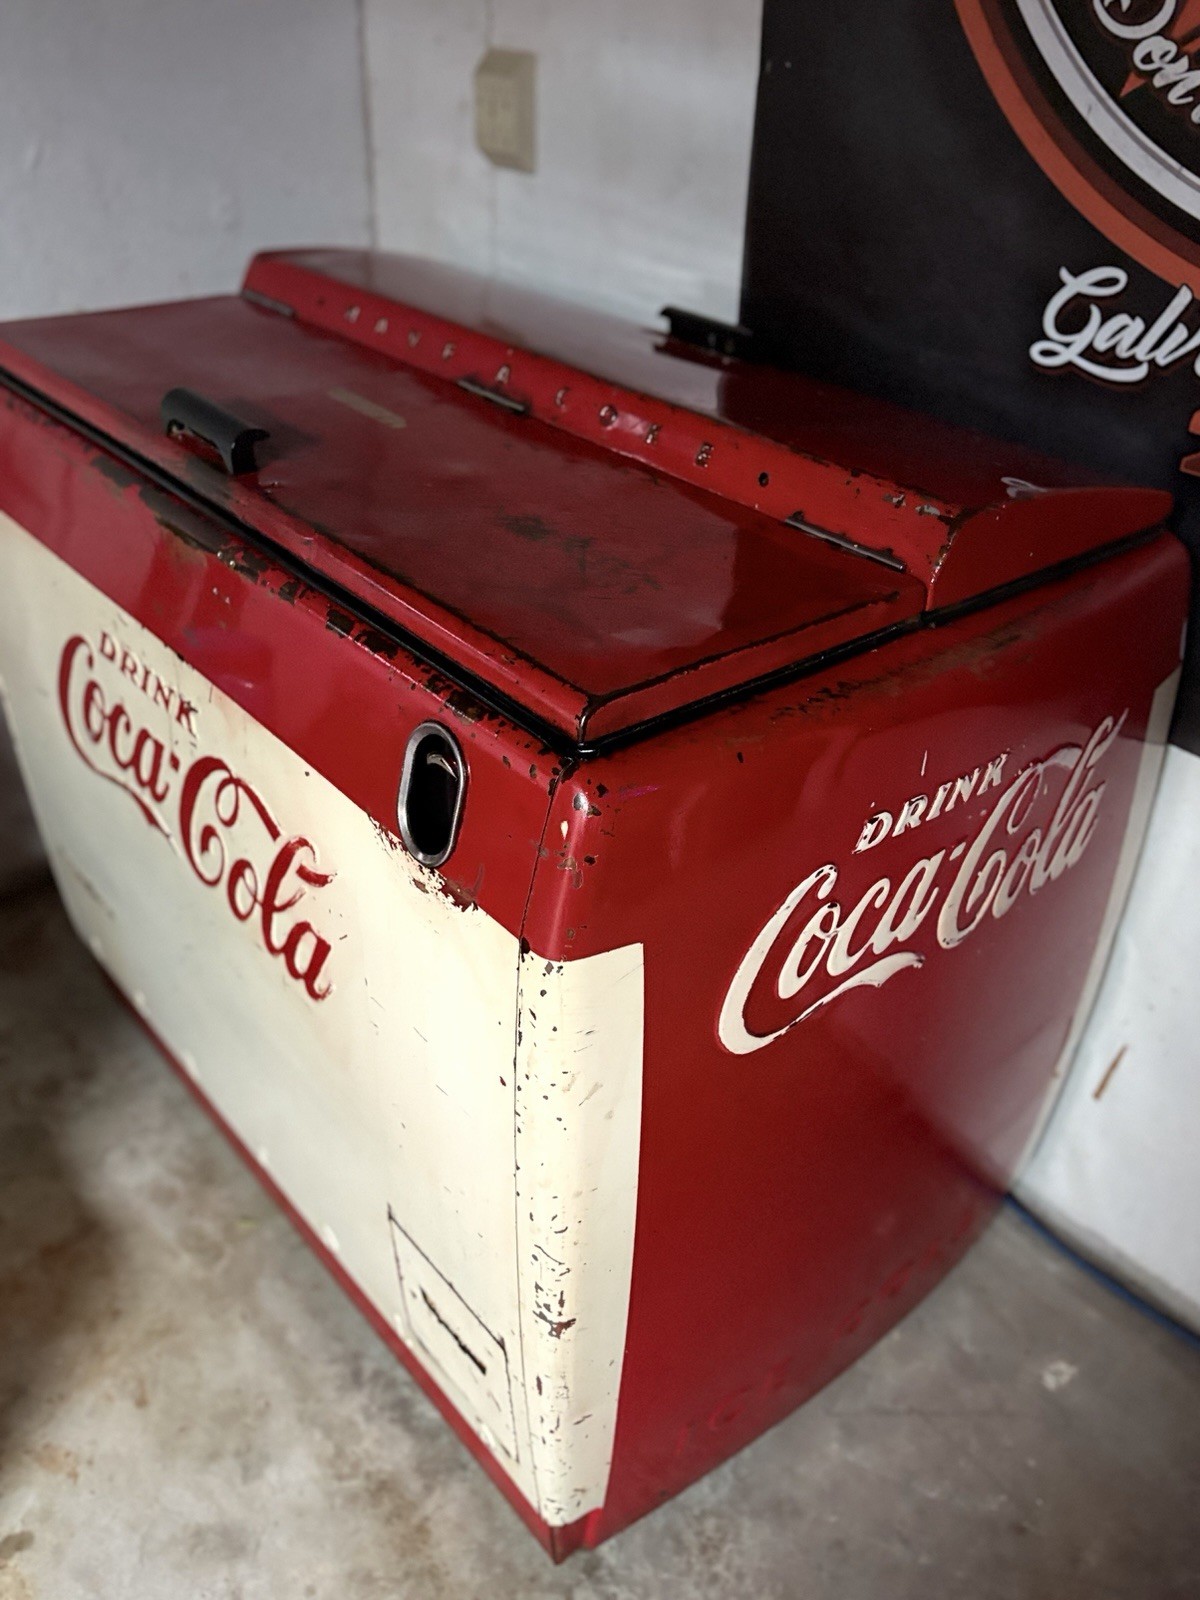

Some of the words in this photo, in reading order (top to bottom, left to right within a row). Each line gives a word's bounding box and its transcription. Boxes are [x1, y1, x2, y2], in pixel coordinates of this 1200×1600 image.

[1029, 265, 1200, 383] Galv
[100, 631, 199, 738] DRINK
[58, 634, 335, 1001] Coca-Cola
[852, 752, 1009, 854] DRINK
[718, 708, 1129, 1055] Coca-Cola
